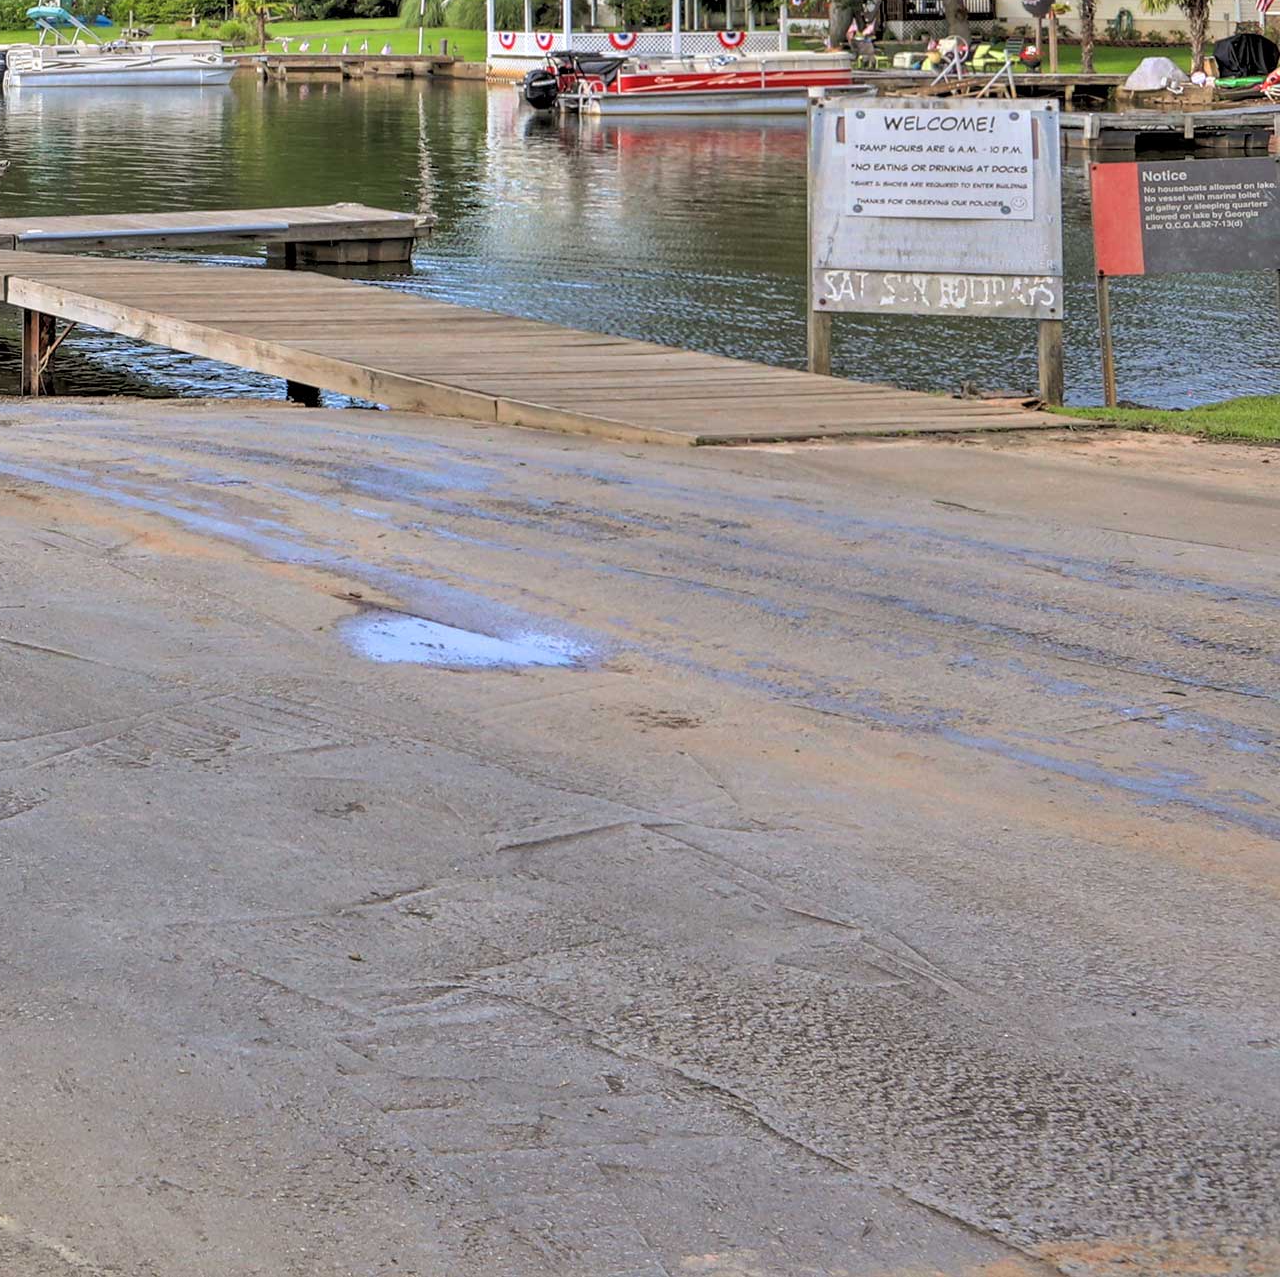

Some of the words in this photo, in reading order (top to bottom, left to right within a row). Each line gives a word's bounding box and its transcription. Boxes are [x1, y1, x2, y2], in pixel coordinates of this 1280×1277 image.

[884, 116, 995, 133] WELCOME!
[927, 145, 945, 153] ARE
[990, 146, 999, 154] 10
[1002, 146, 1022, 154] P.M.
[911, 164, 926, 172] OR
[929, 165, 973, 173] DRINKING
[976, 165, 989, 173] AT
[1142, 170, 1187, 181] Notice
[1158, 185, 1207, 193] houseboats
[1187, 193, 1205, 201] with
[1207, 192, 1236, 200] marine
[1238, 191, 1260, 199] toilet
[1156, 203, 1181, 212] galley
[1194, 202, 1230, 210] sleeping
[1231, 201, 1267, 209] quarters
[1145, 212, 1177, 221] allowed
[1193, 211, 1210, 219] lake
[1212, 211, 1222, 219] by
[1225, 210, 1259, 218] Georgia
[824, 271, 869, 302] SAT
